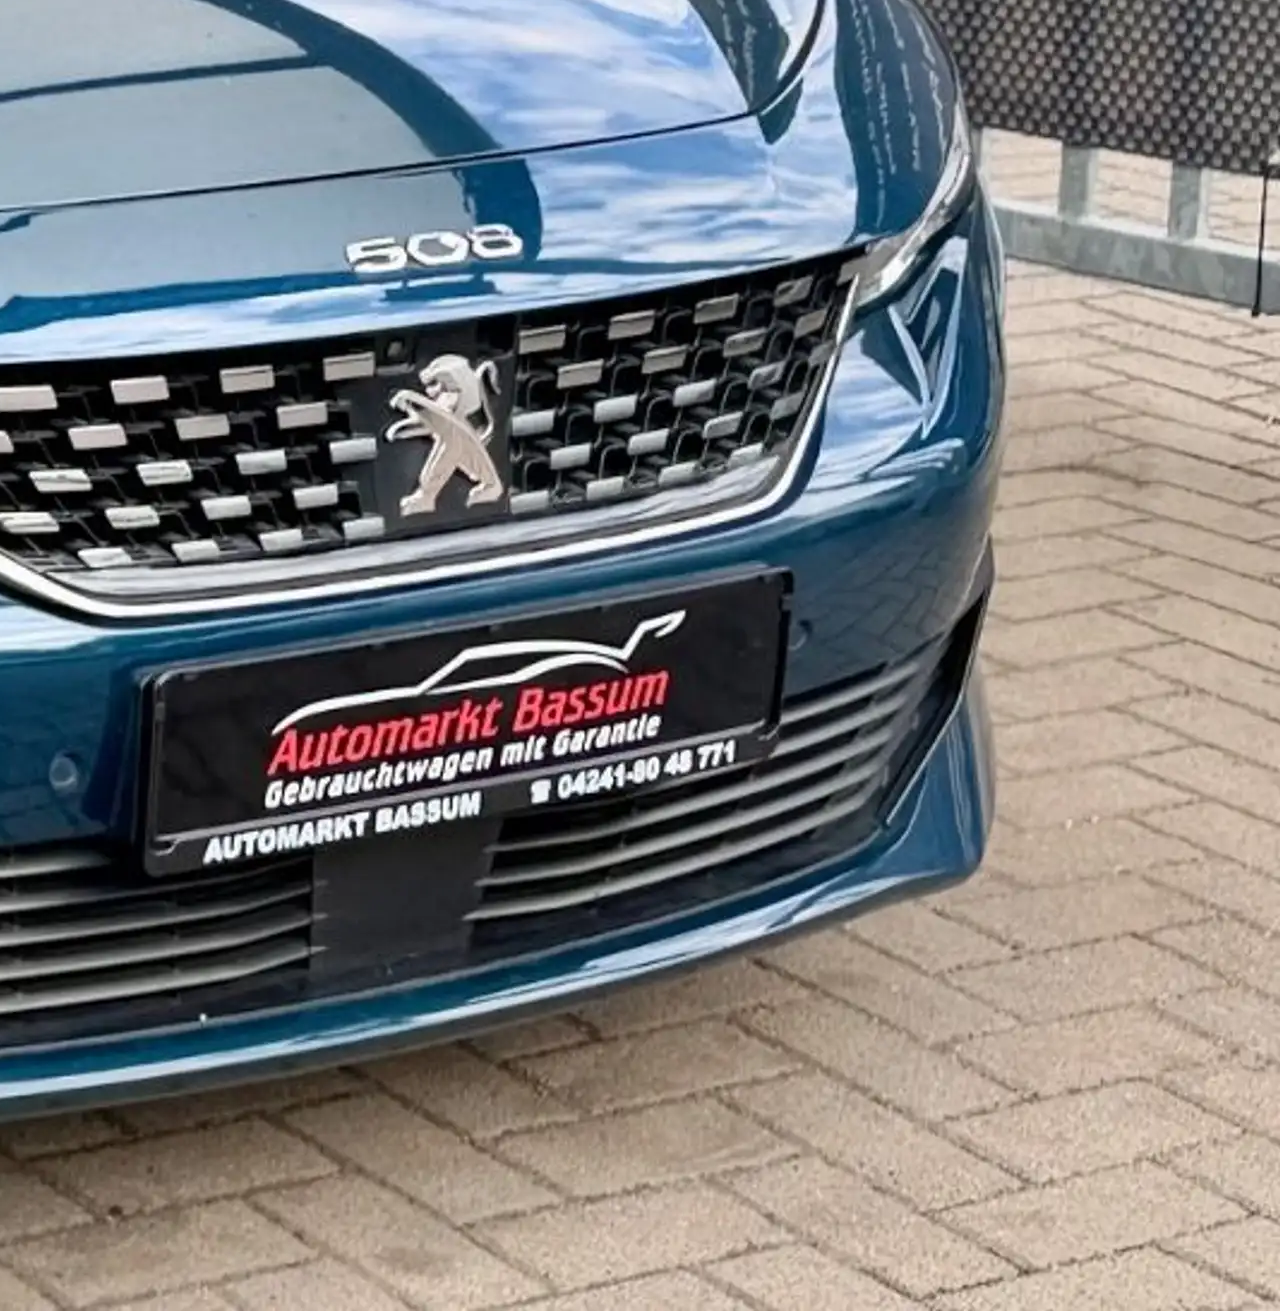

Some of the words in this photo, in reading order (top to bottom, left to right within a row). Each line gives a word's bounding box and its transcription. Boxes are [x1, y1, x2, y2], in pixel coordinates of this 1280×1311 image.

[346, 223, 524, 274] 508
[267, 697, 504, 776] Automarkt
[513, 669, 670, 733] Bassum
[265, 744, 493, 809] Gebrauchtwagen
[500, 736, 546, 766] mit
[552, 713, 662, 757] Garantie
[557, 757, 661, 799] 04241-80
[664, 749, 692, 776] 48
[697, 739, 736, 770] 771
[203, 811, 368, 864] AUTOMARKT
[374, 791, 482, 833] BASSUM
